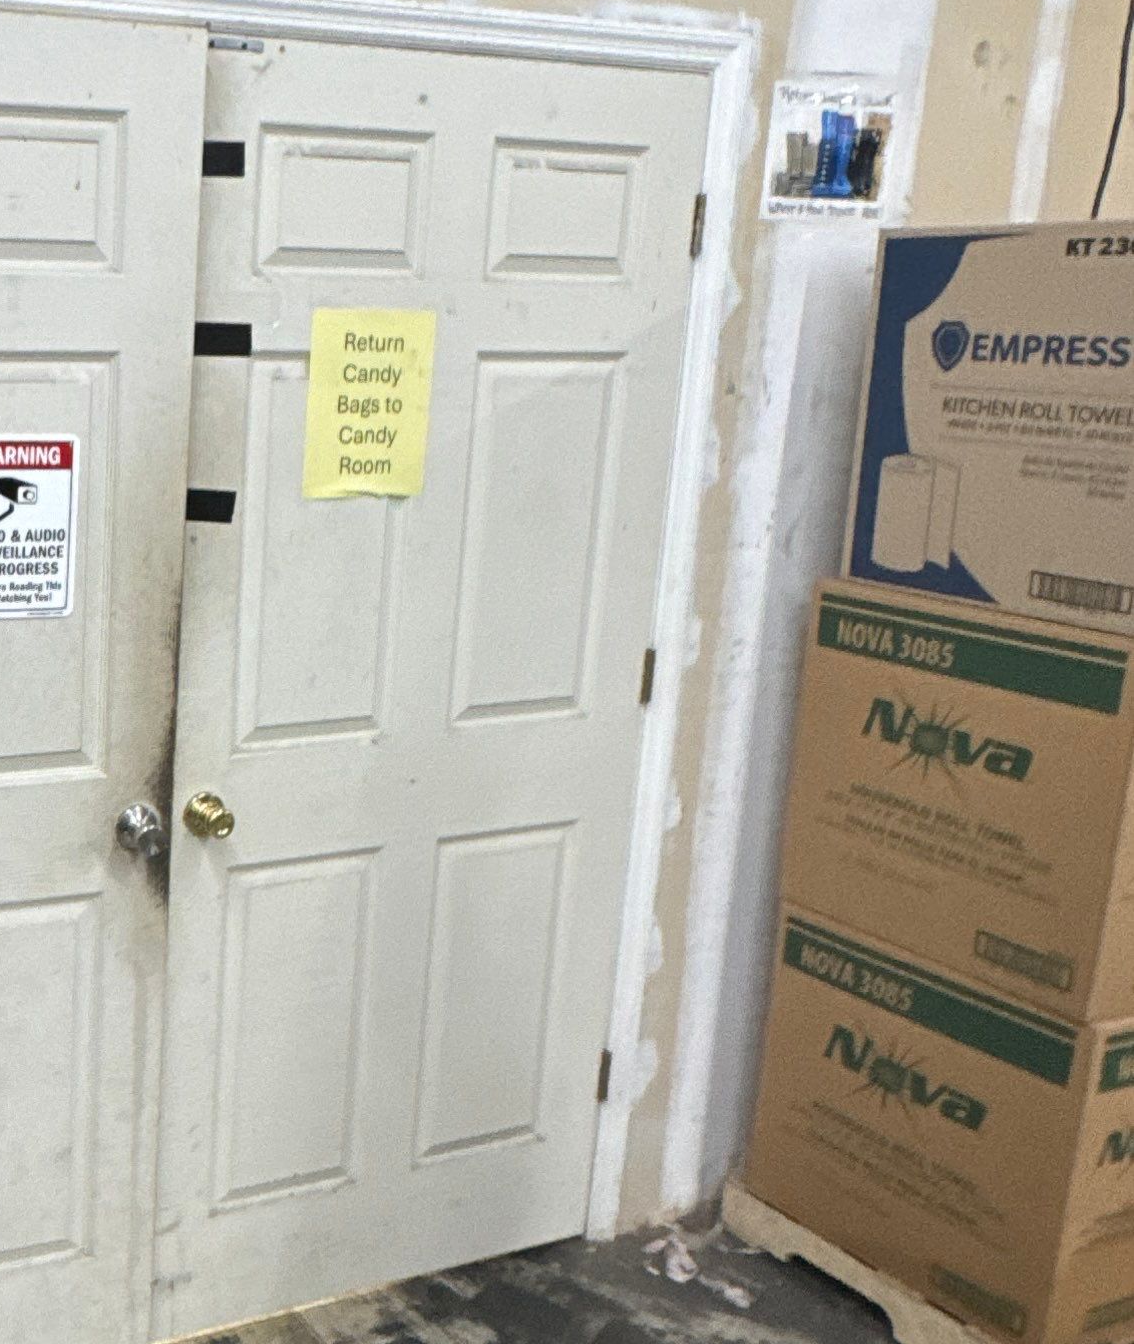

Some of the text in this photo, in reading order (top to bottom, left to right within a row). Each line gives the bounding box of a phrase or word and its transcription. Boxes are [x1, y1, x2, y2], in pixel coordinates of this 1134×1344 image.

[1066, 236, 1134, 256] KT 23
[344, 332, 405, 352] Return
[970, 333, 1131, 367] EMPRESS
[343, 363, 402, 387] Candy
[337, 394, 403, 418] Bags to
[942, 396, 1016, 418] KITCHEN
[1018, 401, 1062, 421] ROLL
[339, 425, 398, 447] Candy
[339, 456, 391, 475] Room
[10, 529, 21, 542] &
[25, 528, 66, 542] AUDIO
[9, 582, 43, 593] Reading
[837, 617, 894, 656] NOVA
[861, 696, 1034, 783] Nova
[823, 1024, 989, 1133] Nova
